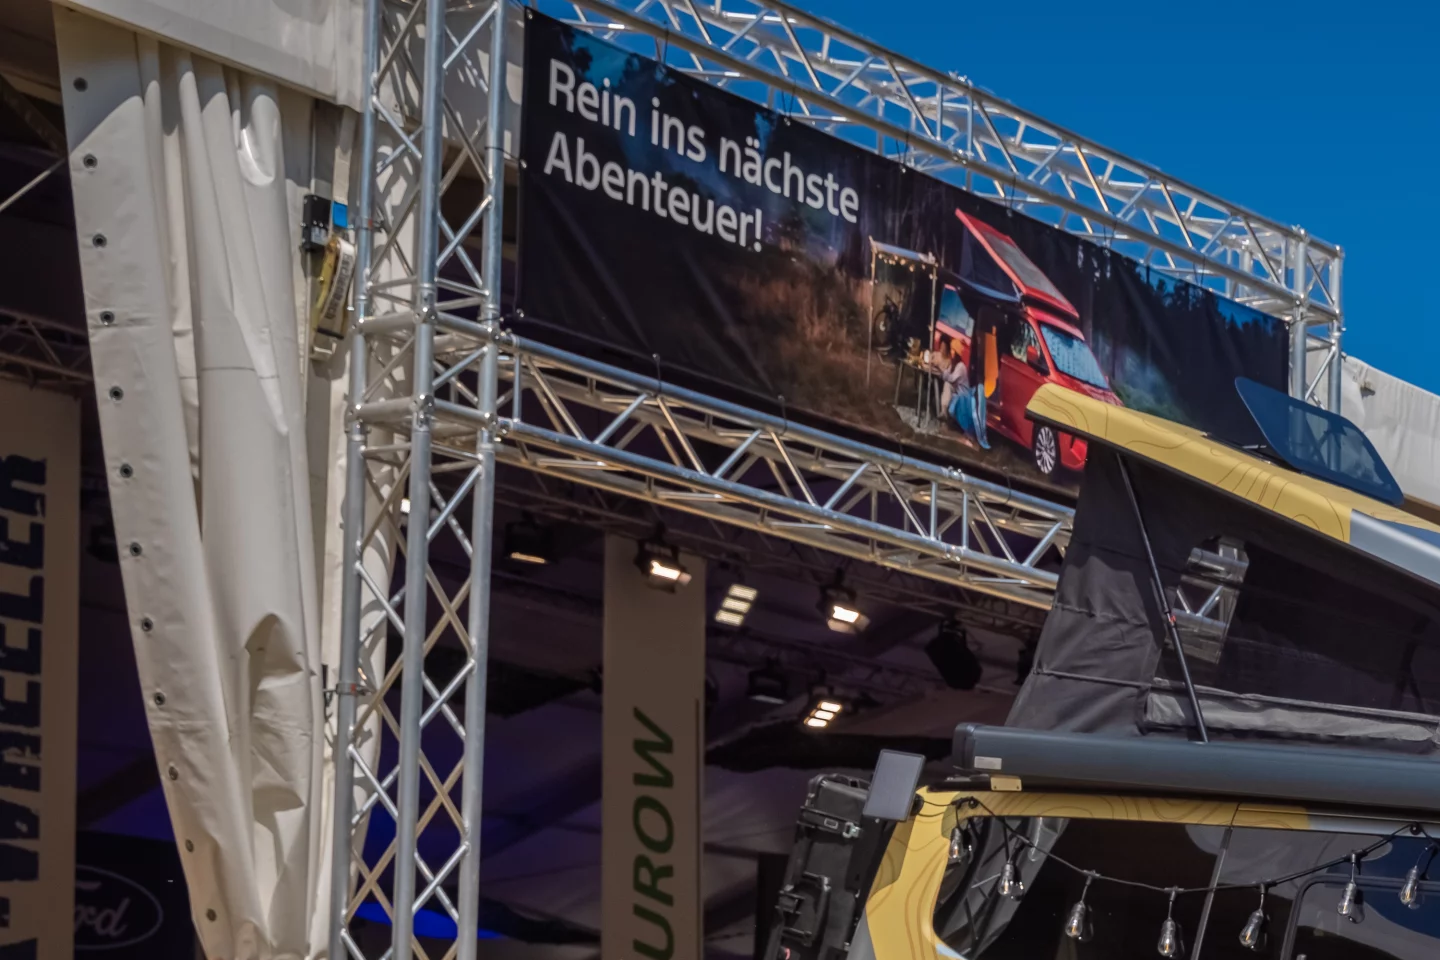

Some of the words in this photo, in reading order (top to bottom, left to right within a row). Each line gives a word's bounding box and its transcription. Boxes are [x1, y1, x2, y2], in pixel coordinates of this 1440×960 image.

[544, 131, 762, 252] Abenteuer!
[549, 57, 636, 137] Rein
[651, 97, 706, 162] ins
[719, 136, 859, 223] nächste
